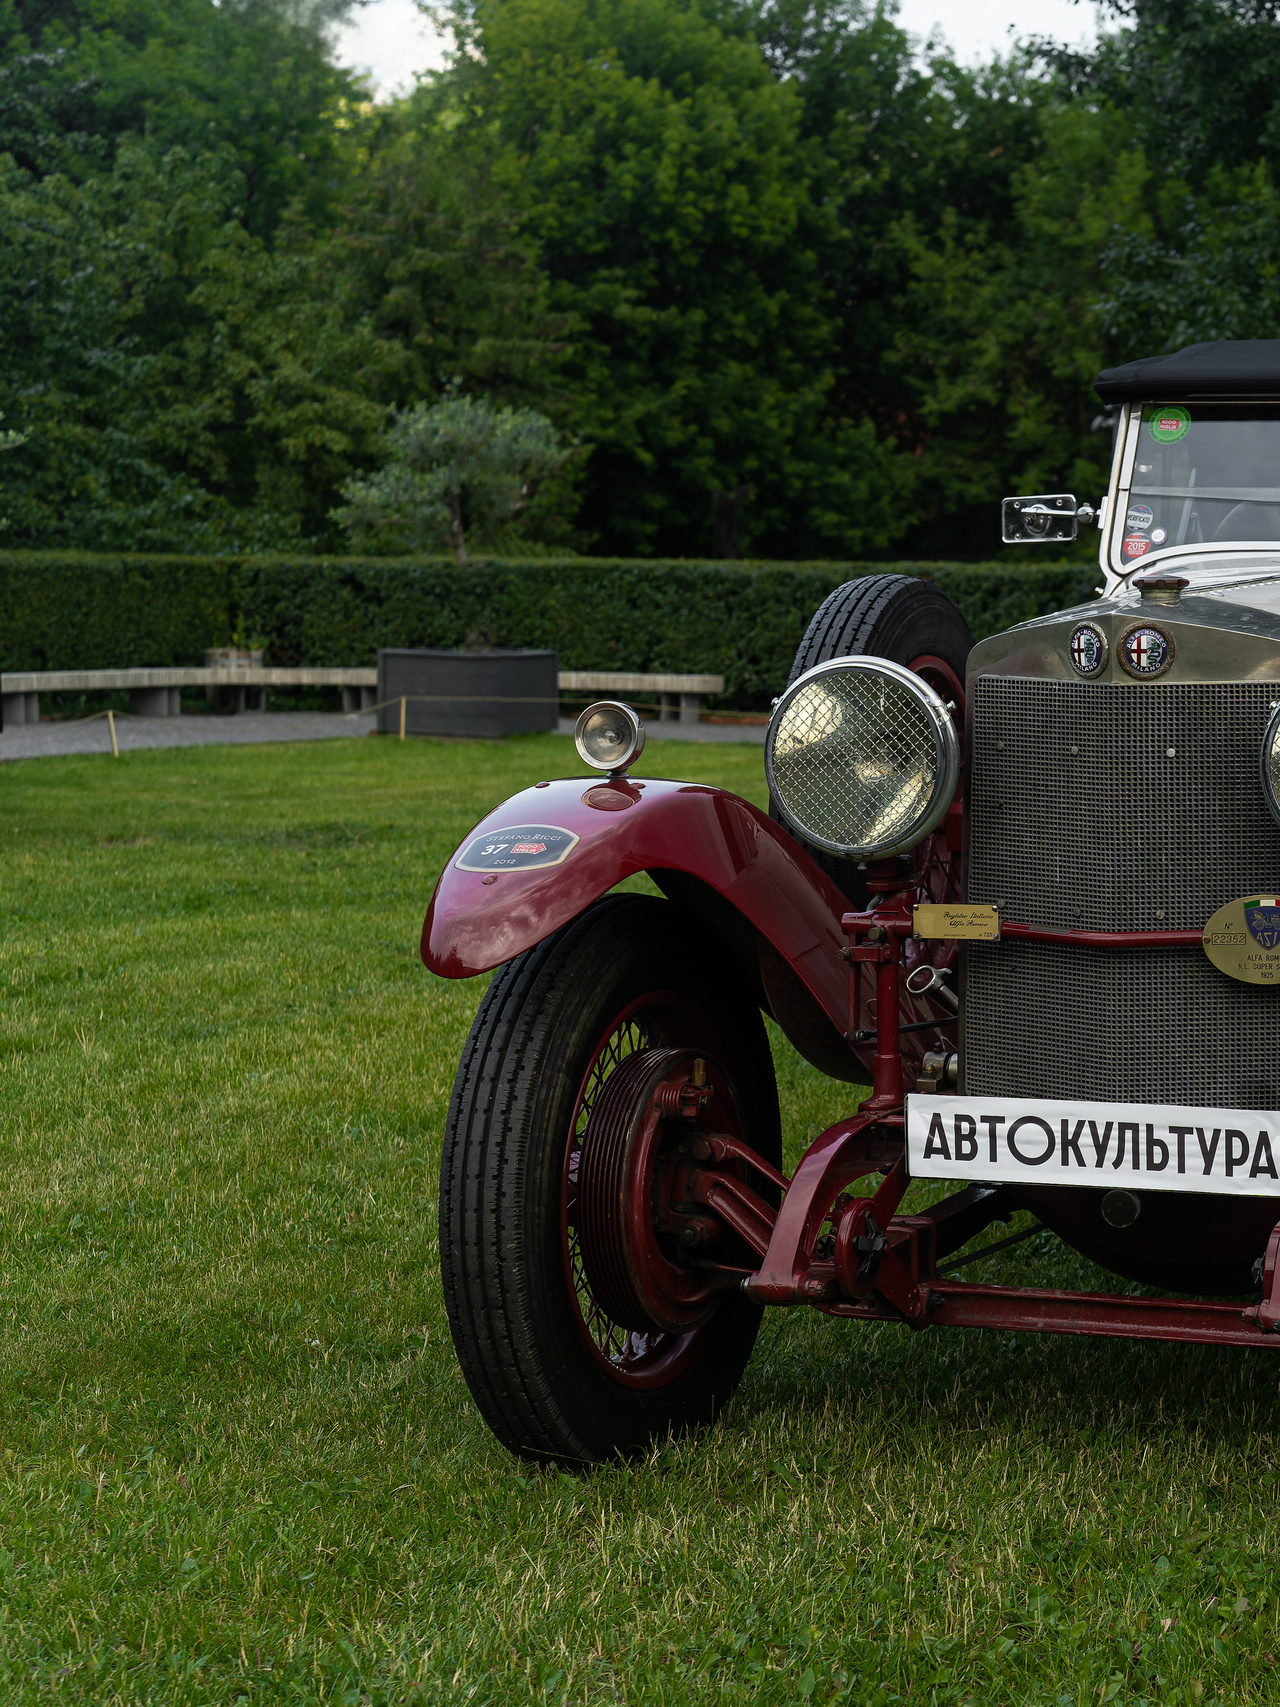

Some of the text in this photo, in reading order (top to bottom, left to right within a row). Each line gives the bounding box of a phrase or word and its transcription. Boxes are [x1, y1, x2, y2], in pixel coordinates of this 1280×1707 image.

[1127, 542, 1146, 551] 2015
[1075, 661, 1098, 672] MILANO
[1131, 661, 1161, 673] MILANO
[486, 833, 562, 842] STEFANO RICCI
[480, 843, 510, 856] 37
[949, 920, 965, 929] Alfa
[1213, 934, 1245, 944] 22352
[1256, 931, 1278, 947] ASI
[1246, 954, 1263, 962] ALFA
[1260, 971, 1274, 979] 1925
[922, 1112, 1280, 1180] АВТОКУЛЬТУРА
